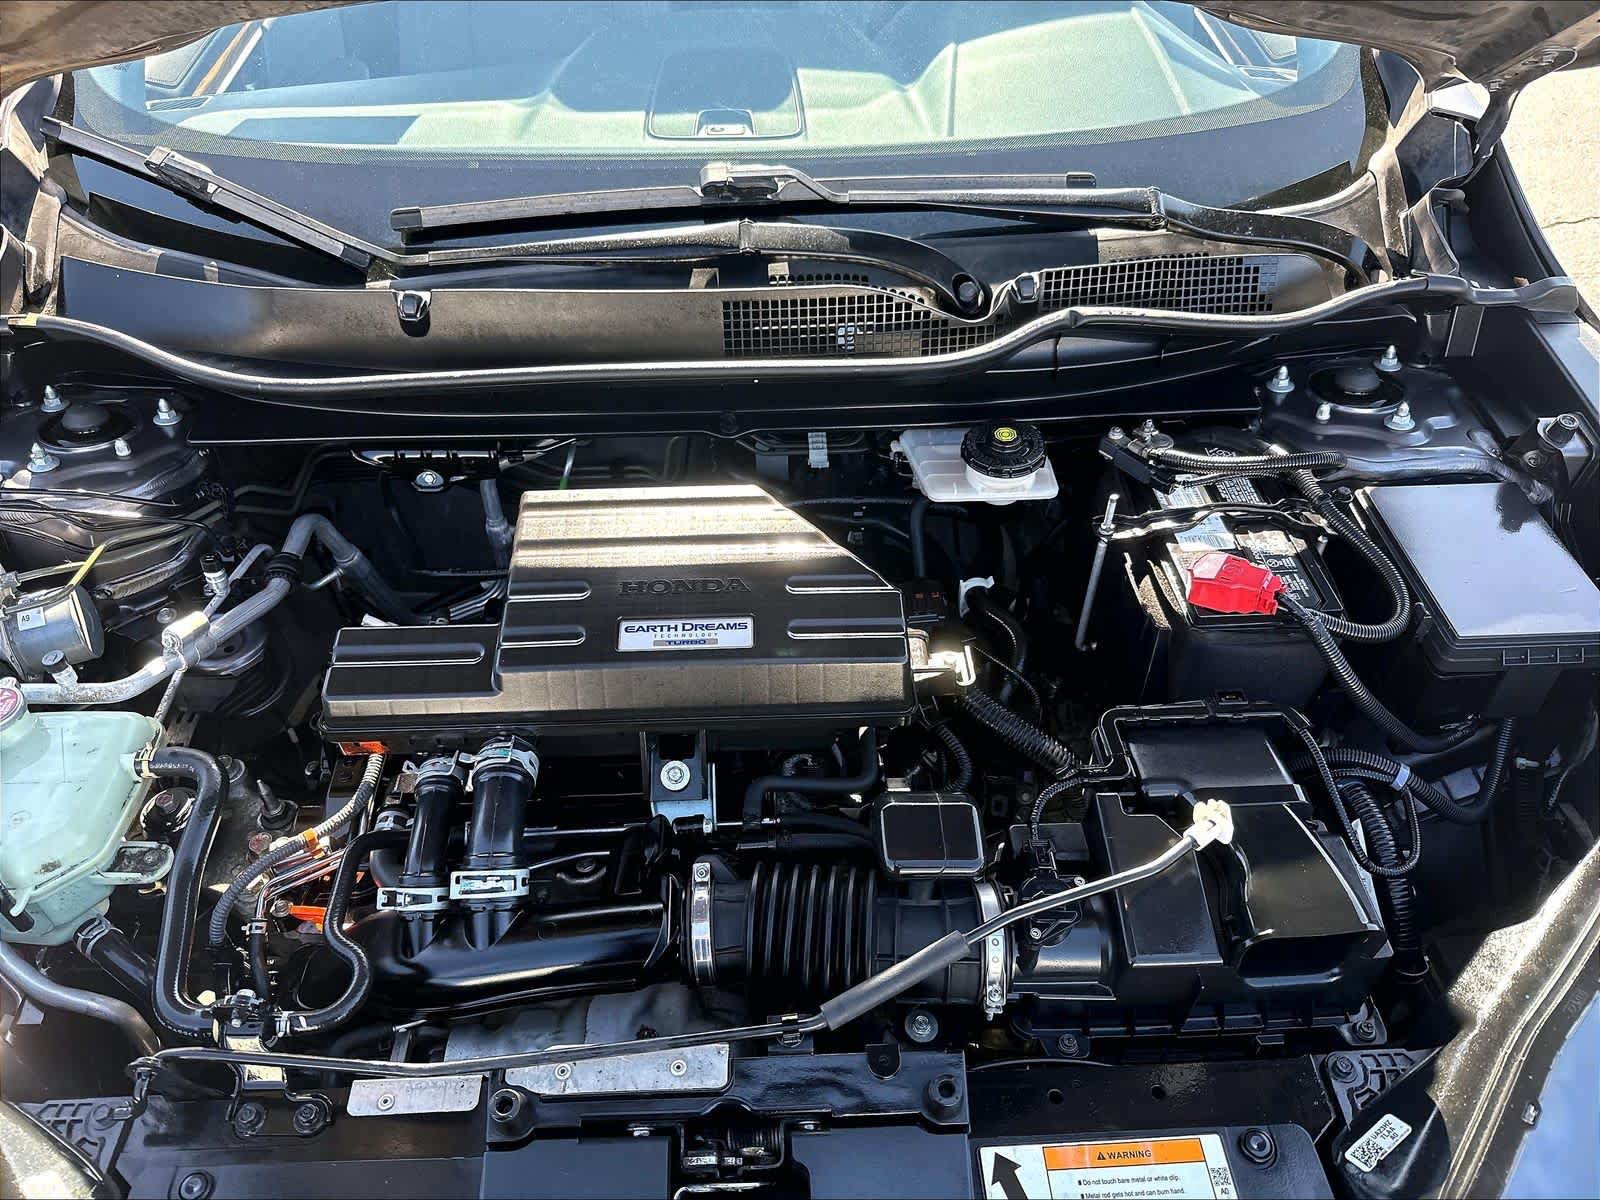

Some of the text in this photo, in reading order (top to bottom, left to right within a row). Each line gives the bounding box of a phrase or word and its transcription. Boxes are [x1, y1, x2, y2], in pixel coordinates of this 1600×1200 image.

[618, 578, 752, 595] HONDA
[624, 622, 748, 633] EARTH DREAMS
[1106, 1149, 1152, 1160] WARNING
[1112, 1191, 1123, 1199] gets
[1156, 1188, 1170, 1196] burn
